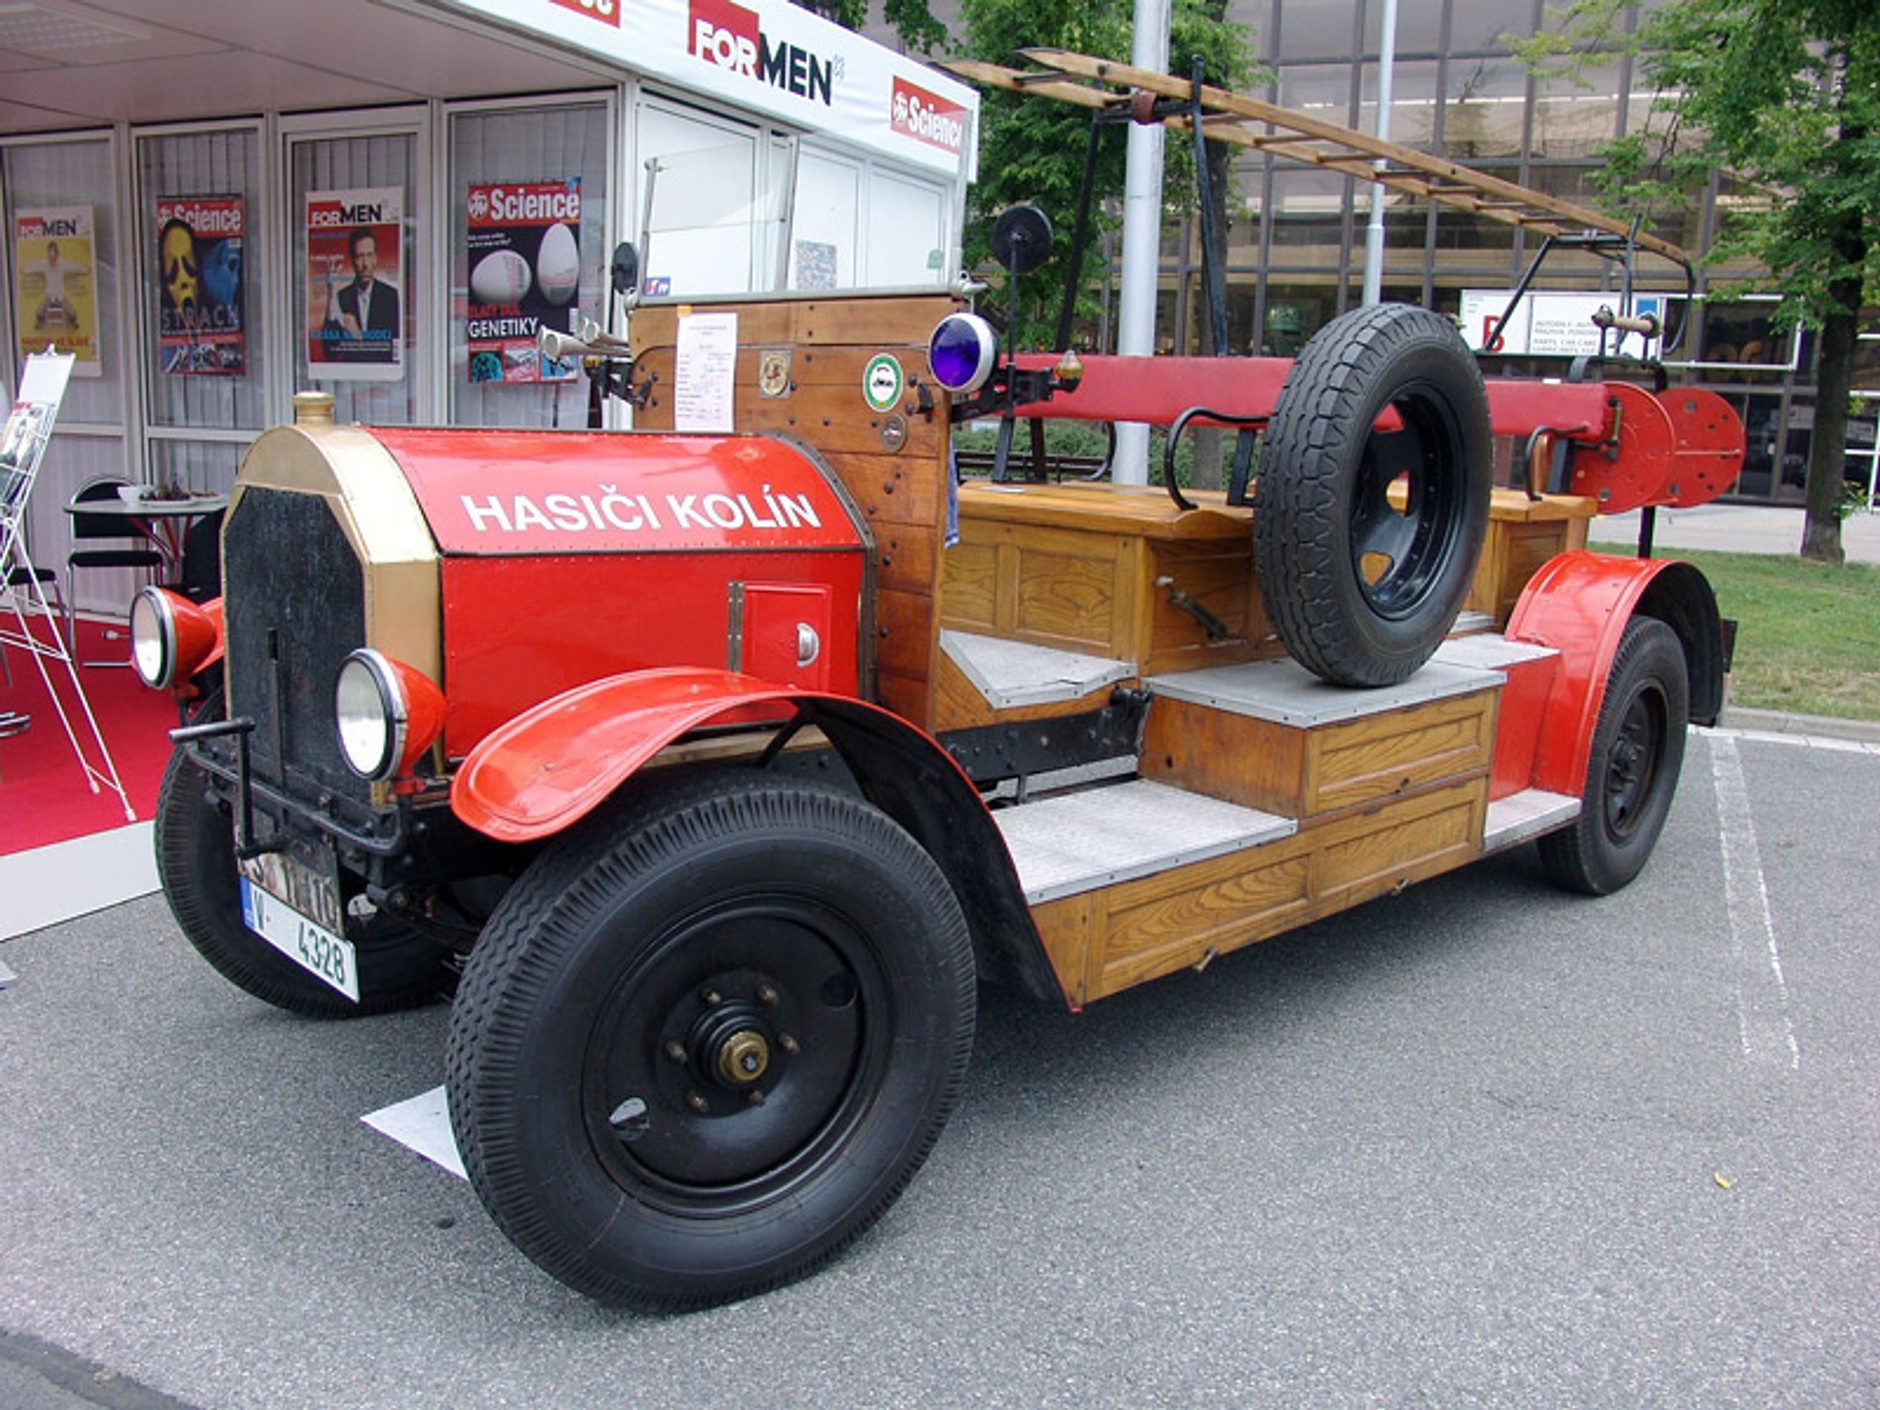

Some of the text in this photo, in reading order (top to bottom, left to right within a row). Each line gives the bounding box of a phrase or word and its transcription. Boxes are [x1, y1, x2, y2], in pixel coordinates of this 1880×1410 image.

[909, 95, 963, 149] Scienc
[174, 204, 241, 232] Science
[490, 187, 580, 221] Science
[468, 317, 538, 338] GENETIKY
[460, 484, 821, 531] HASIČI KOLÍN
[300, 921, 345, 985] 4328
